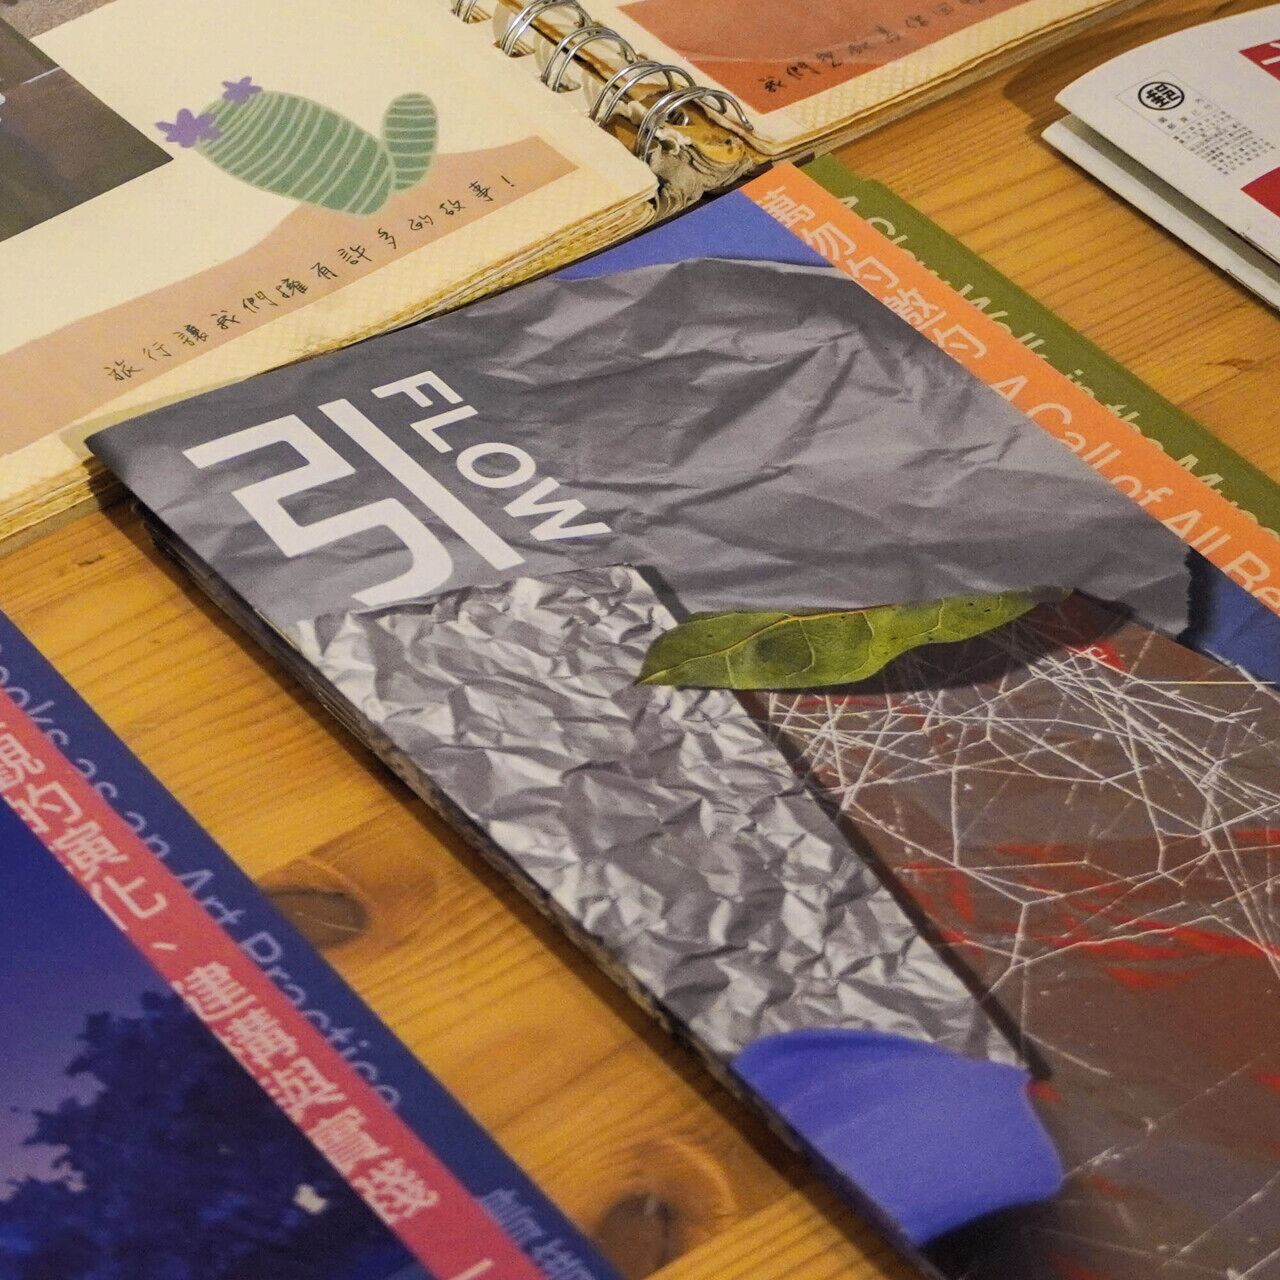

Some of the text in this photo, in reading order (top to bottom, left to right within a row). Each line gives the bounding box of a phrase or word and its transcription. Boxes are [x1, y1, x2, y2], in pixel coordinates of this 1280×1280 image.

[104, 173, 517, 383] 旅行讓我們擁有許多的故事!
[372, 370, 611, 544] FLOW
